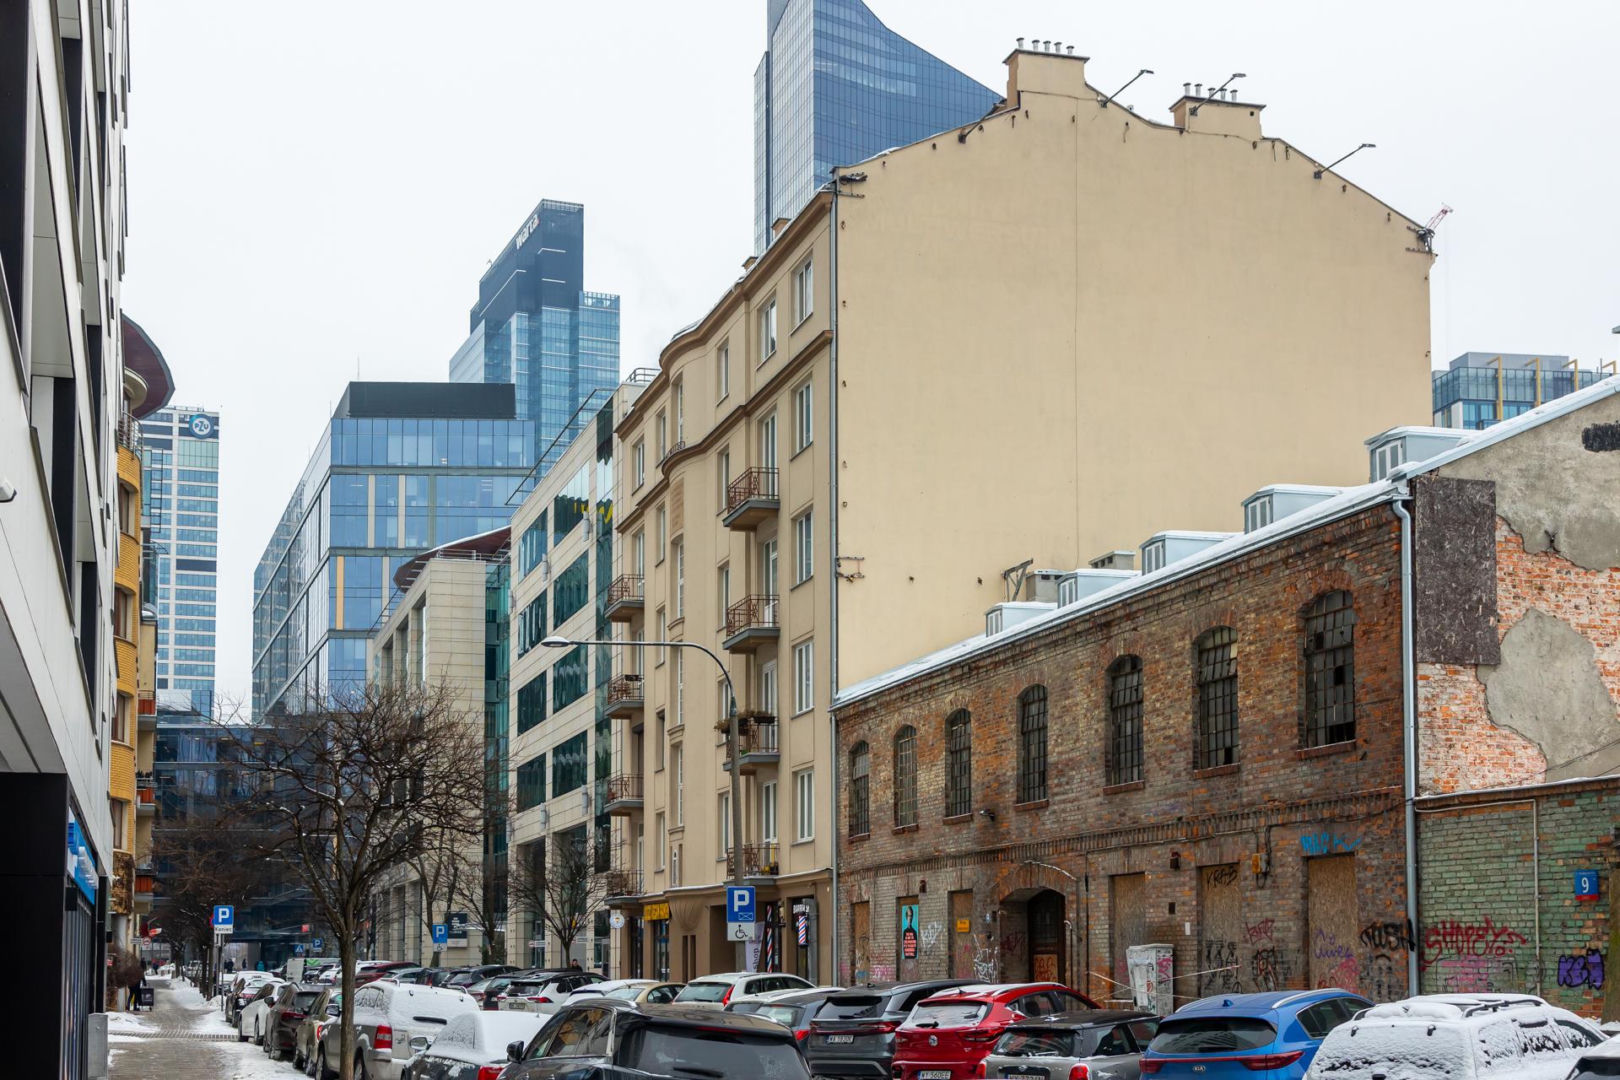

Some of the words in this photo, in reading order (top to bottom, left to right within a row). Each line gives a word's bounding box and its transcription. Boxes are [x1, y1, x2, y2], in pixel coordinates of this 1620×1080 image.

[1581, 877, 1590, 893] 9
[733, 889, 750, 913] P
[218, 908, 230, 923] P
[436, 925, 445, 938] P
